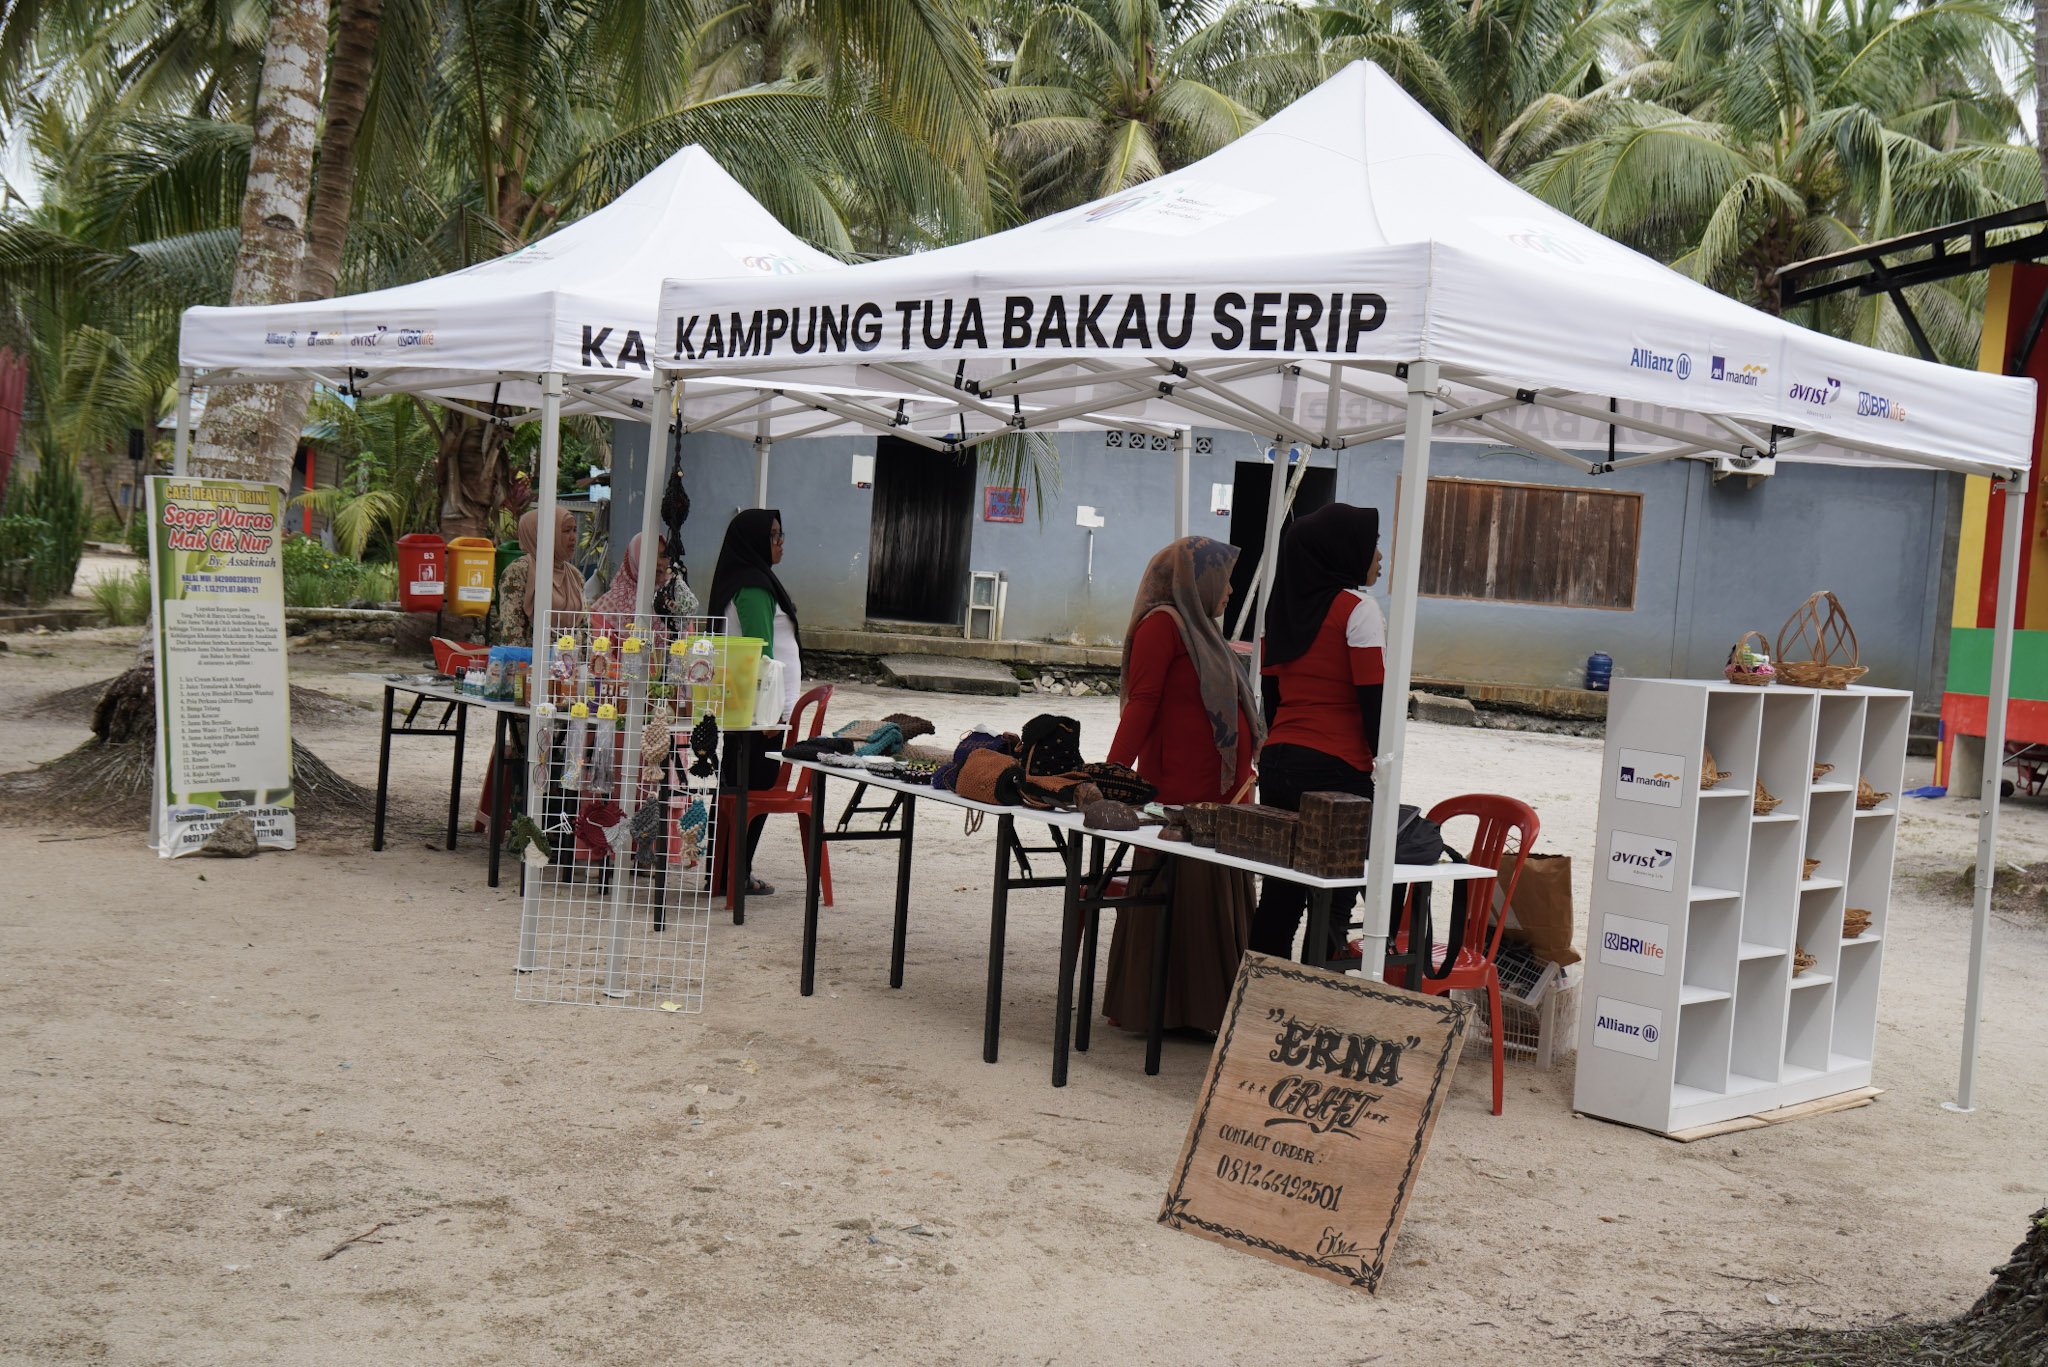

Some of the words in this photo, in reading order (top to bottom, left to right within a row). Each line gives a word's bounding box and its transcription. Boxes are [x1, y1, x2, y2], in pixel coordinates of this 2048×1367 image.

[675, 302, 883, 360] KAMPUNG
[896, 297, 988, 350] TUA
[1002, 294, 1197, 349] BAKAU
[1211, 292, 1387, 353] SERIP
[1630, 348, 1673, 374] Allianz
[1725, 370, 1758, 387] mandiri
[1789, 383, 1829, 405] avrist
[165, 484, 191, 500] CAFÉ
[192, 487, 236, 503] HEALTHY
[237, 490, 270, 505] DRINK
[163, 504, 216, 531] Seger
[218, 506, 273, 530] Waras
[168, 528, 207, 551] Mak
[210, 530, 237, 552] Cik
[238, 531, 272, 553] Nur
[226, 557, 276, 568] Assakinah
[1636, 776, 1671, 788] mandiri
[176, 813, 204, 822] Samping
[1612, 851, 1656, 869] avrist
[1597, 1016, 1640, 1036] Allianz
[1218, 1124, 1271, 1153] CONTACT
